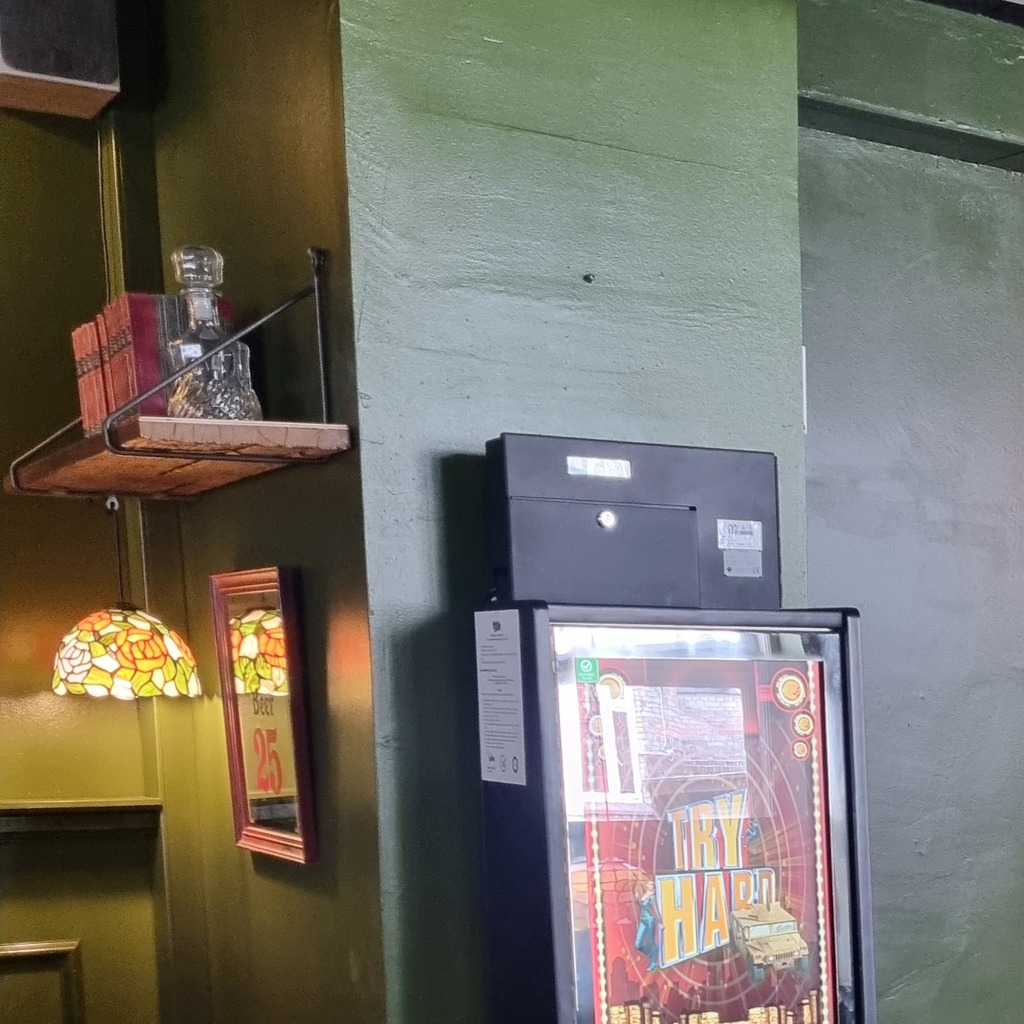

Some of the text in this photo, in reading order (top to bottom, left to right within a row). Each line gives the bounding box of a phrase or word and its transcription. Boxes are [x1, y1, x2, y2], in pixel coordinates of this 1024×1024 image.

[252, 691, 274, 716] Beer
[253, 728, 283, 795] 25
[667, 788, 748, 871] TRY
